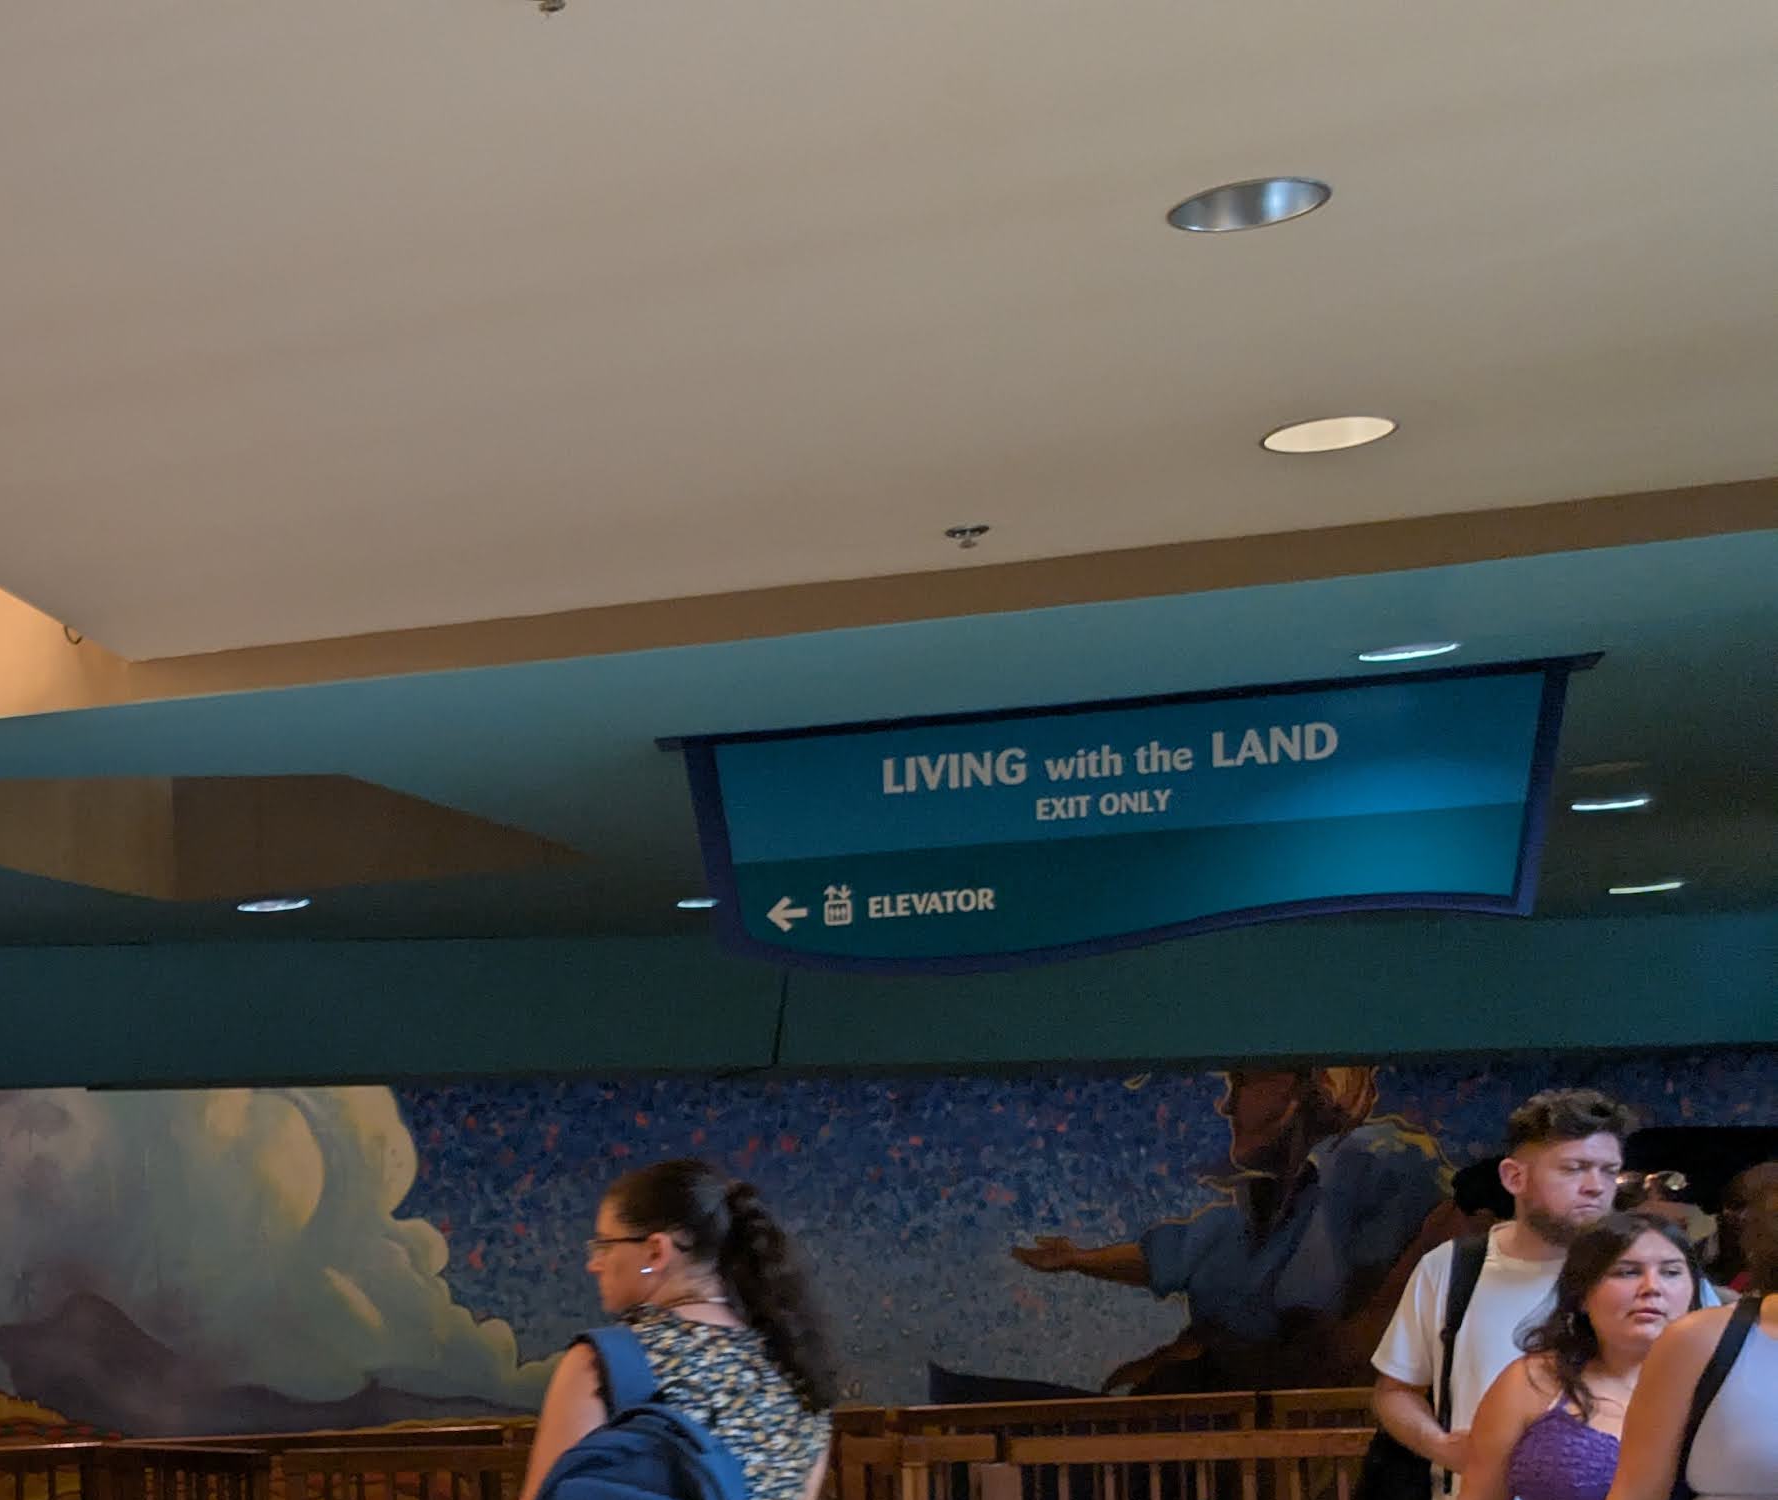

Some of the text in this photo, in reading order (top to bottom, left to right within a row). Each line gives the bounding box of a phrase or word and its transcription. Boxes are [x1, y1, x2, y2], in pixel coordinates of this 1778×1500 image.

[882, 722, 1339, 794] LIVING with the LAND
[1036, 789, 1173, 821] EXIT ONLY
[868, 888, 995, 919] ELEVATOR
